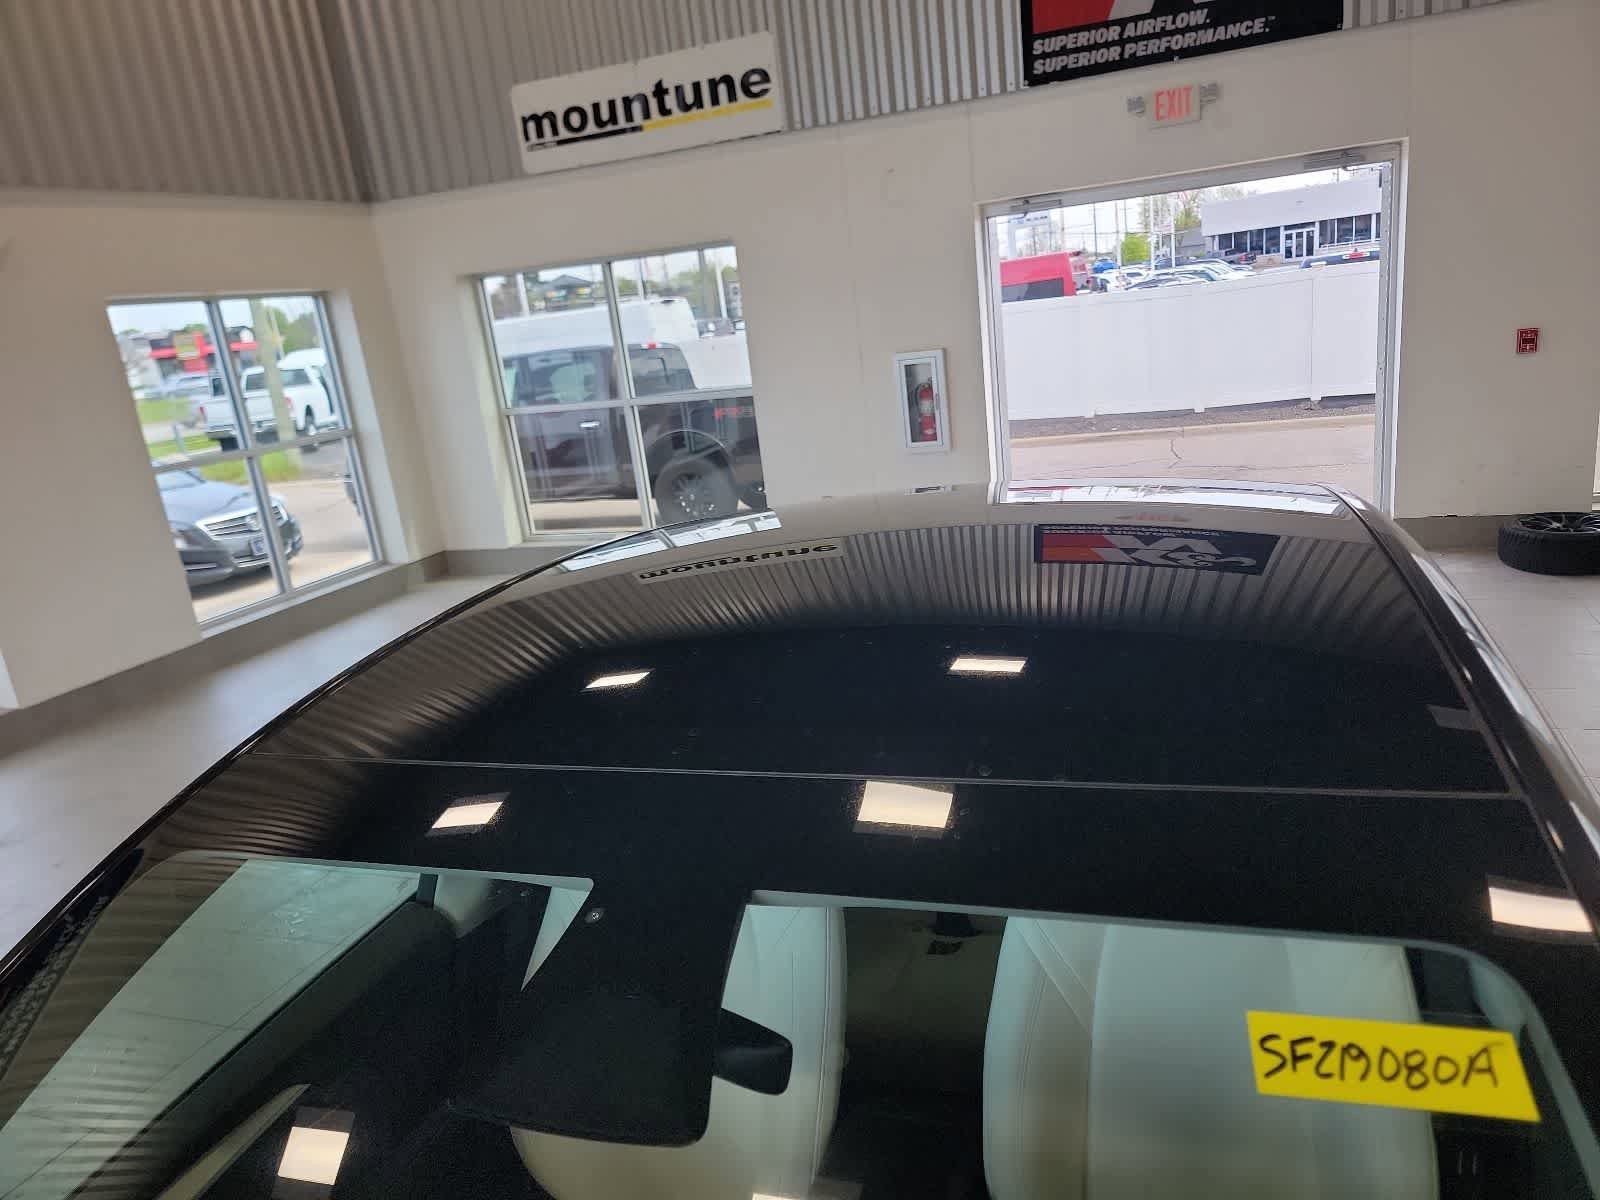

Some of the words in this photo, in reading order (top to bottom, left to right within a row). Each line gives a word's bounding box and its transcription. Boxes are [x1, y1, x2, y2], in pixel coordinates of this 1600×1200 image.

[1032, 26, 1121, 56] SUPERIOR
[1123, 8, 1211, 39] AIRFLOW.
[1032, 46, 1121, 75] SUPERIOR
[521, 67, 771, 141] mountune
[1154, 85, 1193, 121] EXIT
